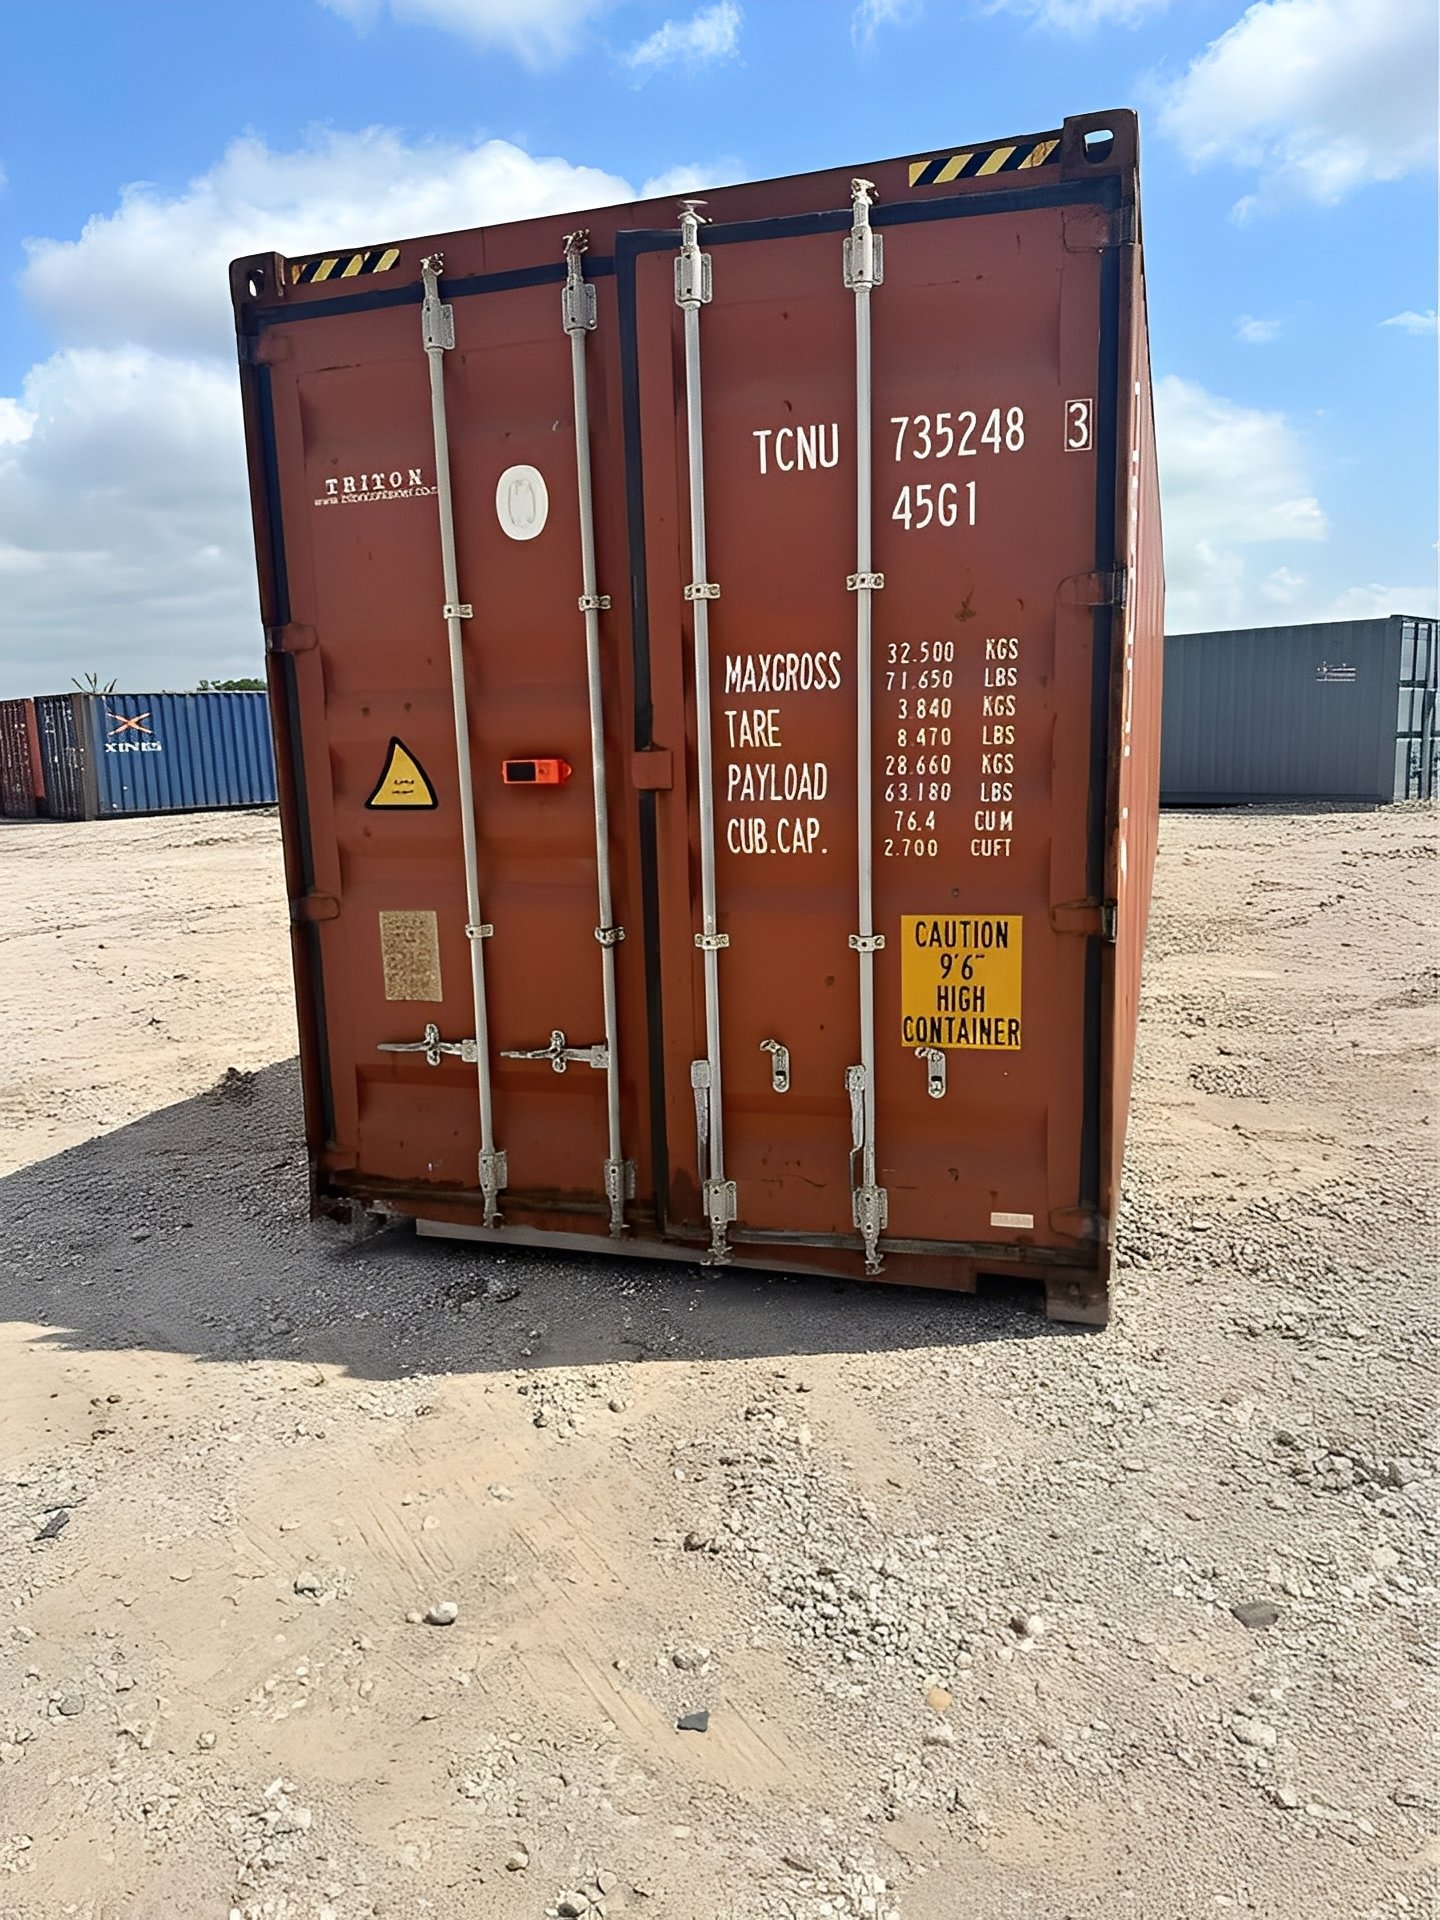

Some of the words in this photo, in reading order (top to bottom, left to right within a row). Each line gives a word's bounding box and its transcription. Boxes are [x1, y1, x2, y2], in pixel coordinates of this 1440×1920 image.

[753, 423, 839, 474] TCNU
[891, 406, 1025, 461] 735248
[1068, 402, 1089, 448] 3
[325, 468, 423, 495] TRITON
[892, 481, 976, 530] 45G1
[725, 651, 841, 694] MAXGROSS
[887, 641, 954, 664] 32.500
[985, 638, 1019, 660] KGS
[886, 669, 953, 691] 71.650
[984, 667, 1017, 687] LBS
[724, 709, 782, 748] TARE
[982, 694, 1016, 717] KGS
[982, 725, 1015, 745] LBS
[727, 762, 828, 802] PAYLOAD
[885, 754, 951, 776] 28.660
[981, 753, 1014, 774] KGS
[885, 782, 951, 802] 63.180
[980, 782, 1013, 802] LBS
[894, 810, 935, 831] 76.4
[884, 838, 938, 856] 2.700
[970, 838, 1011, 857] CUFT
[915, 920, 1008, 948] CAUTION
[937, 985, 985, 1012] HIGH
[903, 1015, 1020, 1046] CONTAINER
